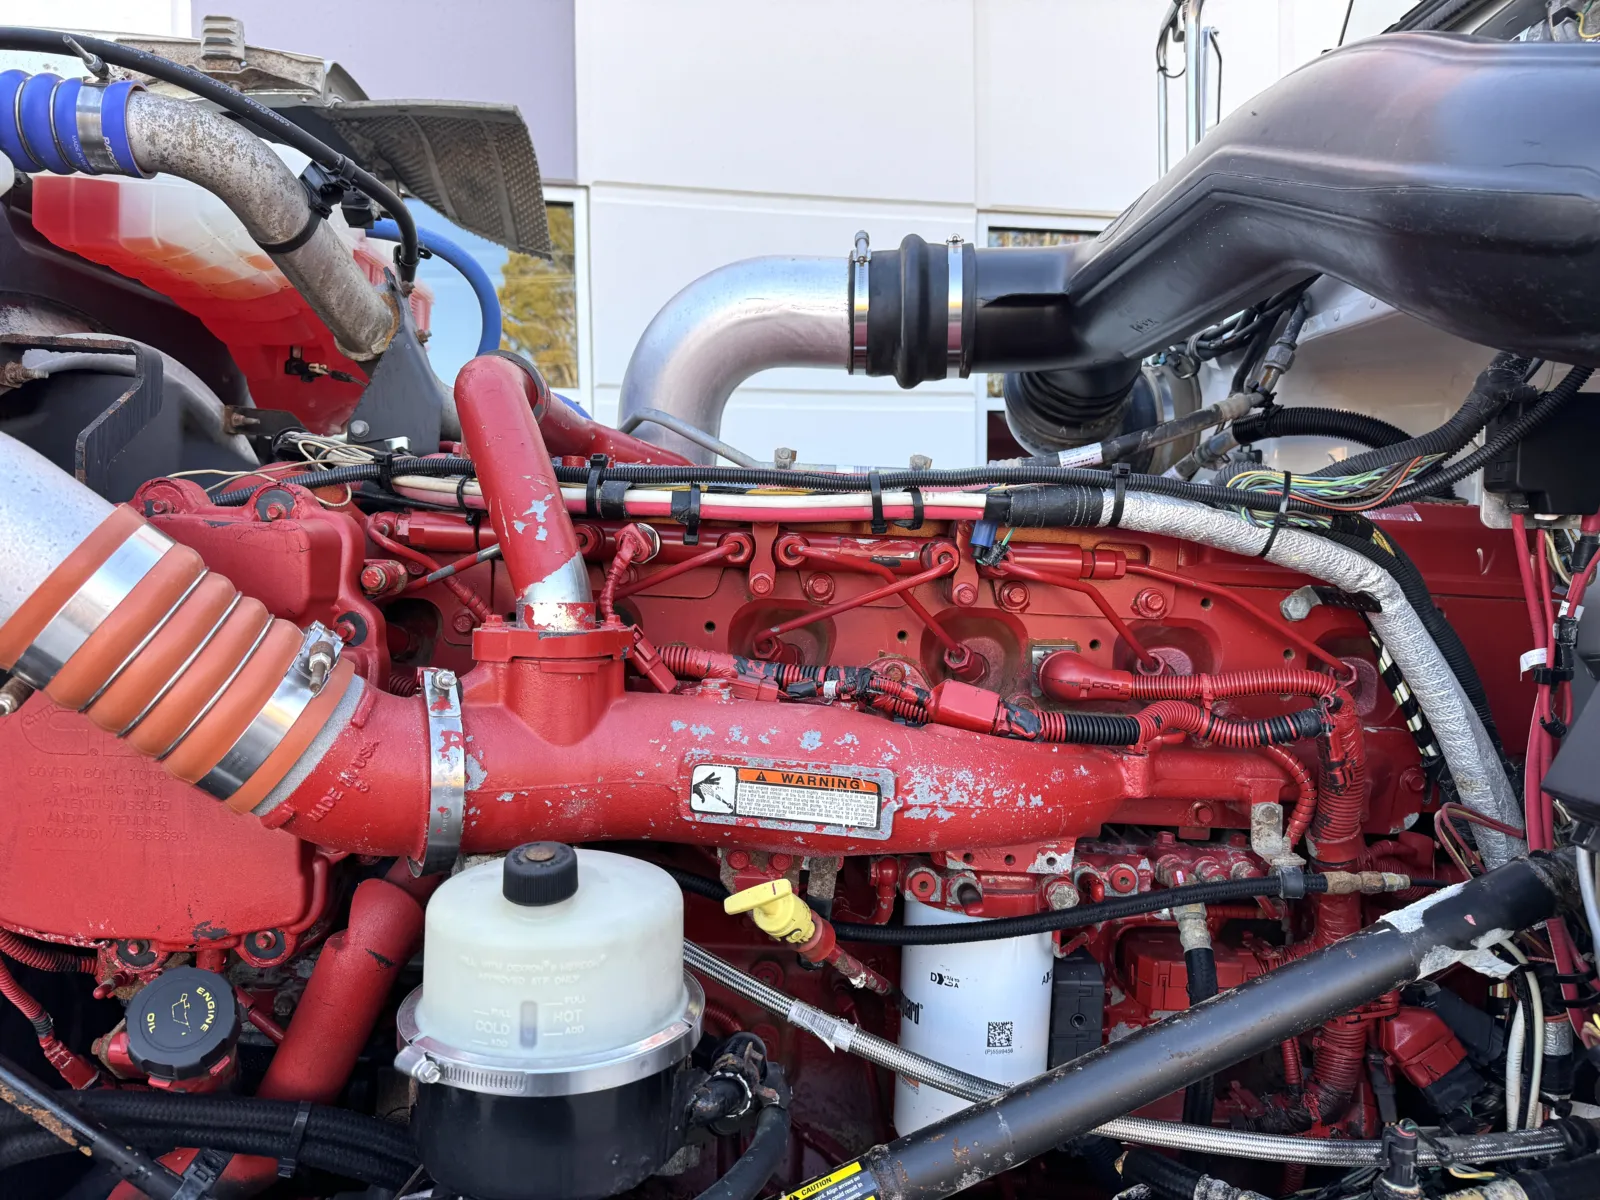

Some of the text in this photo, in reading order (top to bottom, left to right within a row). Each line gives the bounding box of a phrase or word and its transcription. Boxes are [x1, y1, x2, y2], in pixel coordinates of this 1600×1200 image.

[208, 80, 240, 96] GALAXY
[244, 98, 290, 126] GOODYEAR
[28, 766, 72, 778] COVER
[84, 768, 118, 780] BOLT
[781, 773, 860, 790] WARNING
[122, 800, 172, 812] ISSUED
[307, 788, 344, 822] MADE
[108, 814, 168, 826] PENDING
[530, 976, 550, 985] ATF
[554, 974, 580, 984] ONLY
[196, 986, 216, 1032] ENGINE
[554, 1008, 582, 1023] HOT
[146, 1012, 156, 1034] OIL
[475, 1020, 510, 1035] COLD
[564, 1025, 584, 1034] ADD
[801, 1176, 832, 1196] CAUTION
[826, 1186, 838, 1197] Align
